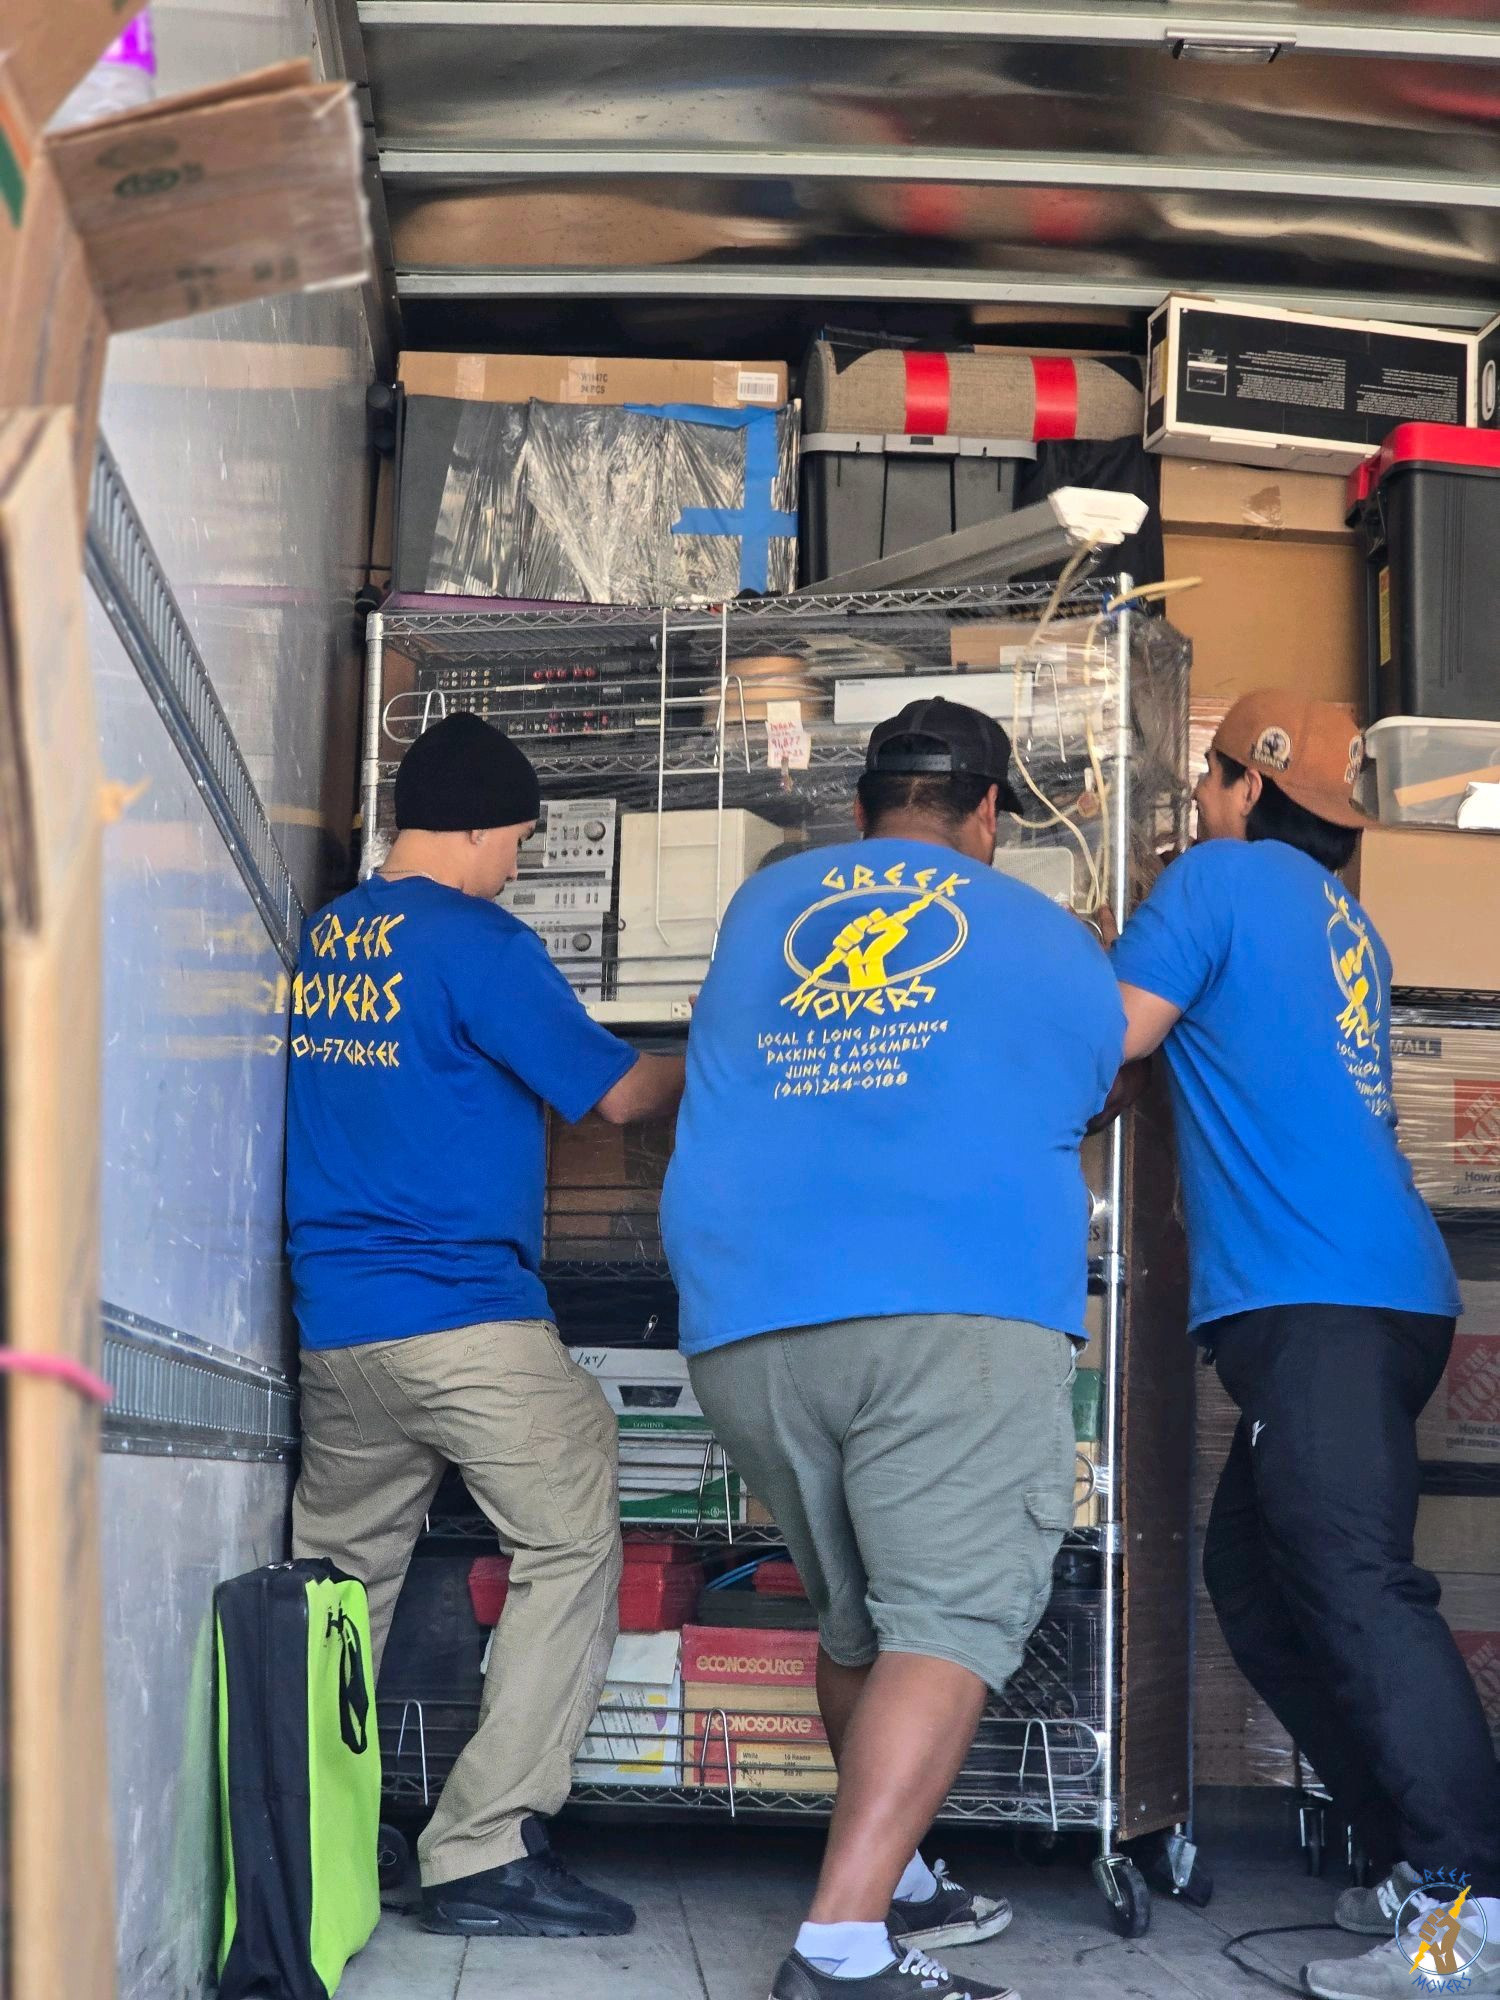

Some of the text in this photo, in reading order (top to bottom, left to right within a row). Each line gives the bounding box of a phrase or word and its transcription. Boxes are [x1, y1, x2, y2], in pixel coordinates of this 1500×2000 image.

[821, 862, 971, 897] GREEK
[780, 976, 936, 1020] MOVERS
[758, 1032, 799, 1049] LOCAL
[823, 1027, 862, 1044] LONG
[870, 1020, 949, 1040] DISTANCE
[1391, 1039, 1436, 1054] MALL
[767, 1047, 826, 1065] PACKING
[849, 1035, 931, 1058] ASSEMBLY
[785, 1056, 901, 1080] JUNK REMOVAL
[1465, 1171, 1491, 1182] How
[696, 1655, 804, 1676] econosource
